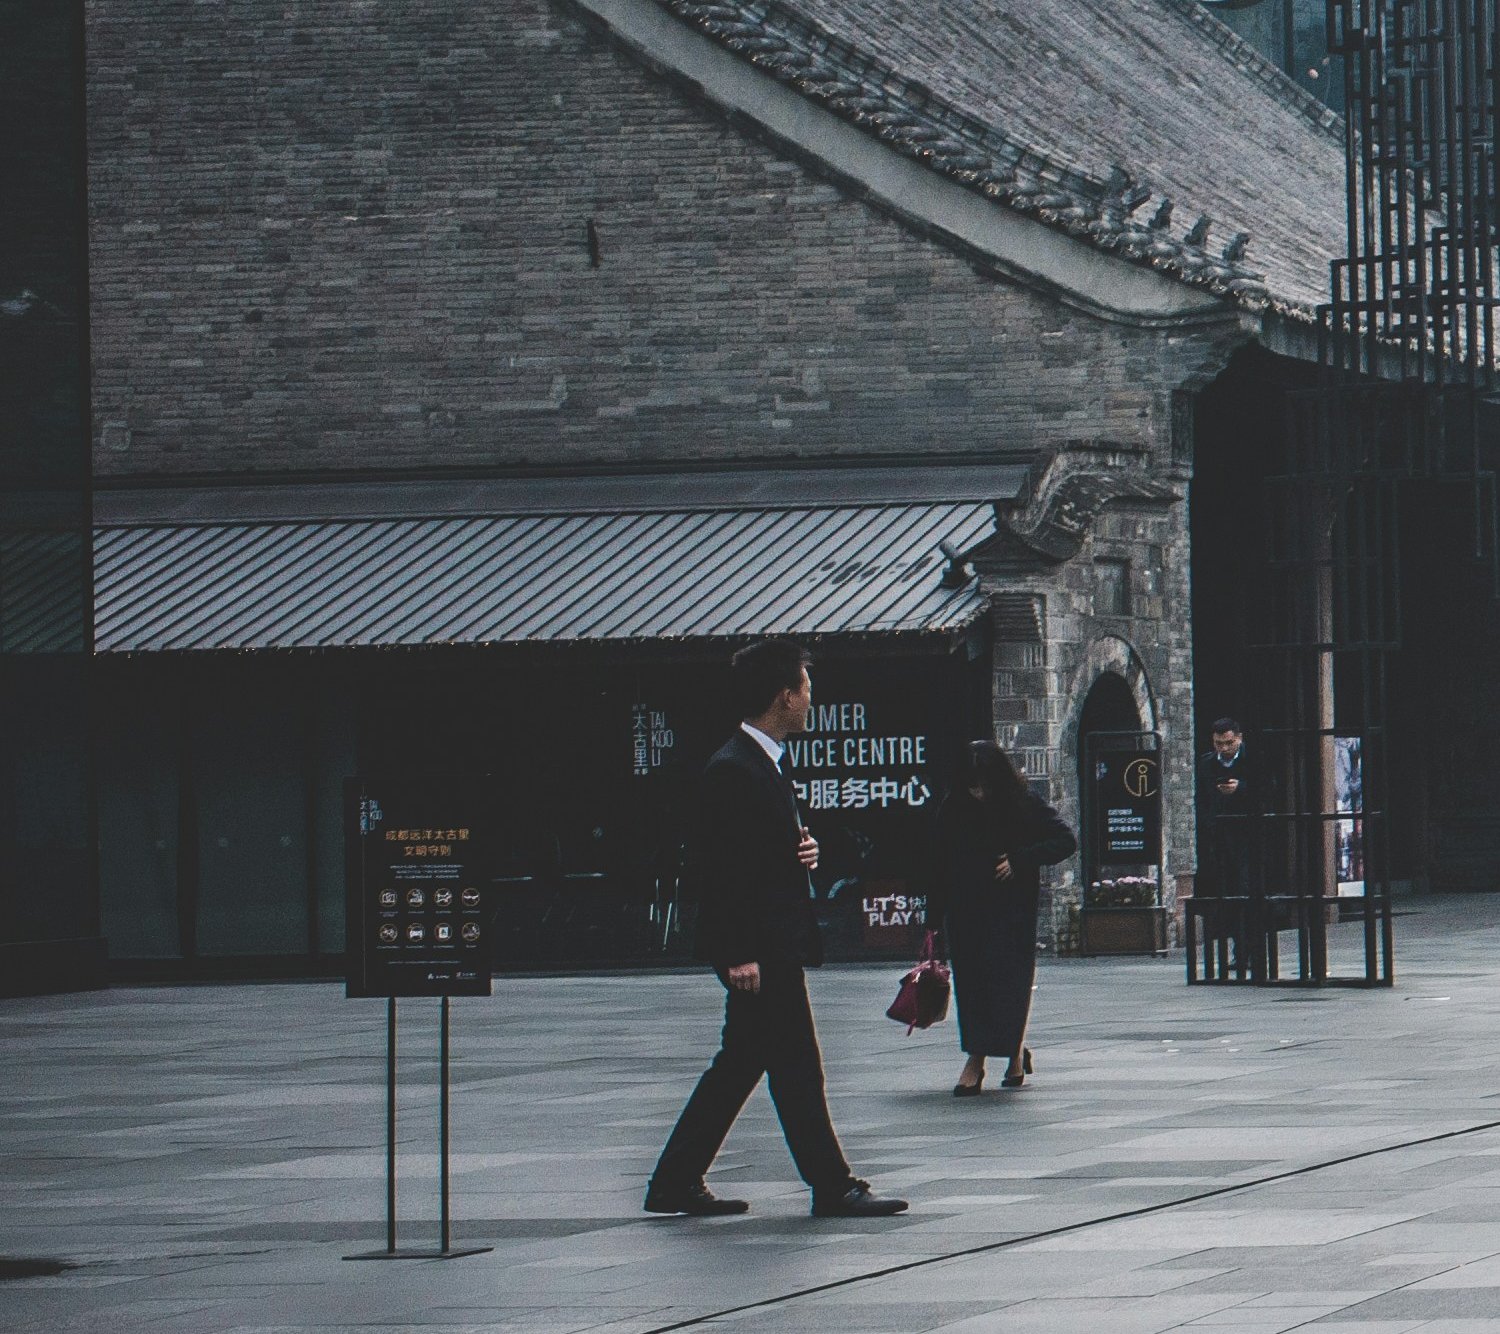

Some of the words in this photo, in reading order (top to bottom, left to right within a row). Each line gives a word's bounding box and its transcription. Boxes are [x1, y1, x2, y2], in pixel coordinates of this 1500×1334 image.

[804, 702, 867, 733] OMER
[787, 738, 838, 768] VICE
[843, 735, 927, 766] CENTRE
[791, 775, 932, 809] 户服务中心
[868, 911, 913, 927] PLAY
